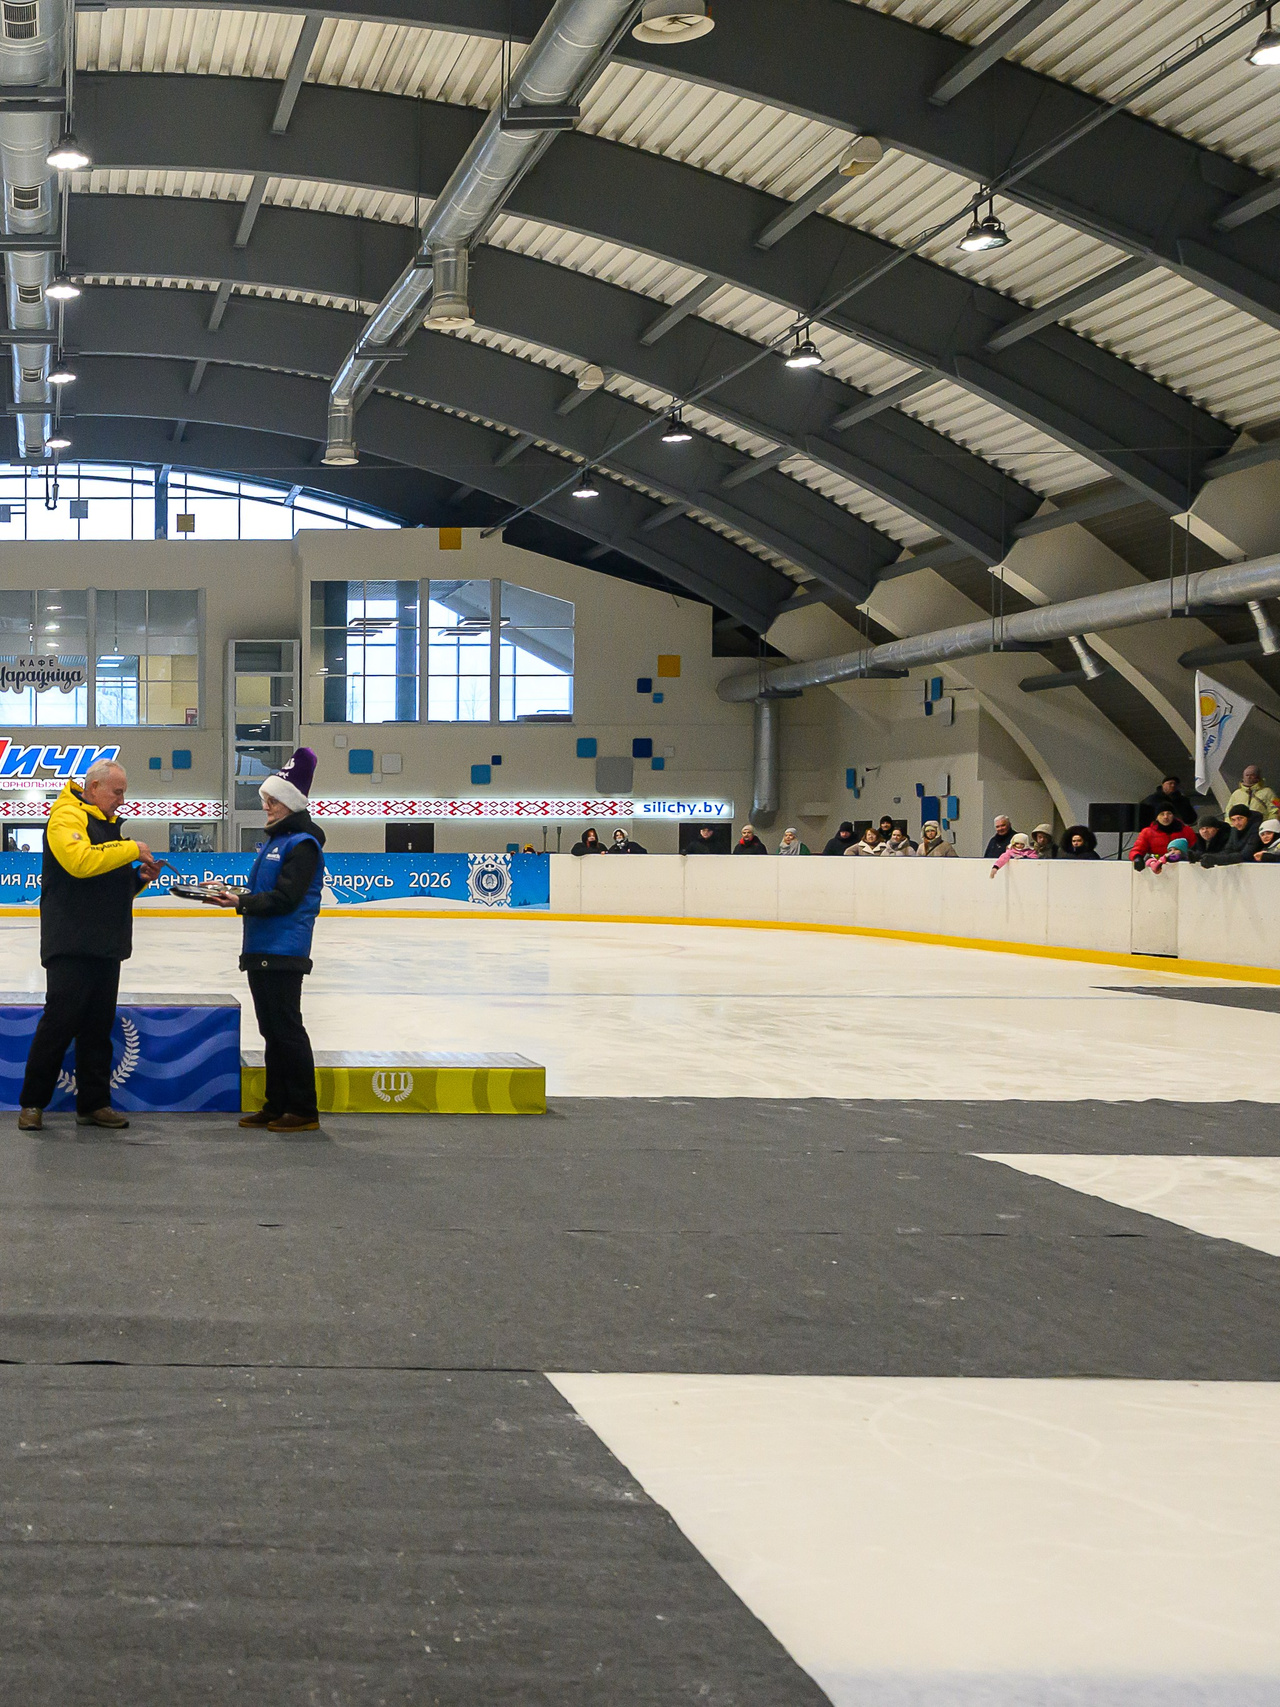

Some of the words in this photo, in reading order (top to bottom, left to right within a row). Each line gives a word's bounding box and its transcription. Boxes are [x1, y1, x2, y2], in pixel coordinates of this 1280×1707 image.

[20, 659, 54, 667] КАФЕ
[643, 801, 724, 815] silichy.by
[148, 874, 199, 889] дента
[322, 874, 394, 891] еларусь
[408, 872, 451, 888] 2026
[379, 1072, 408, 1090] III
